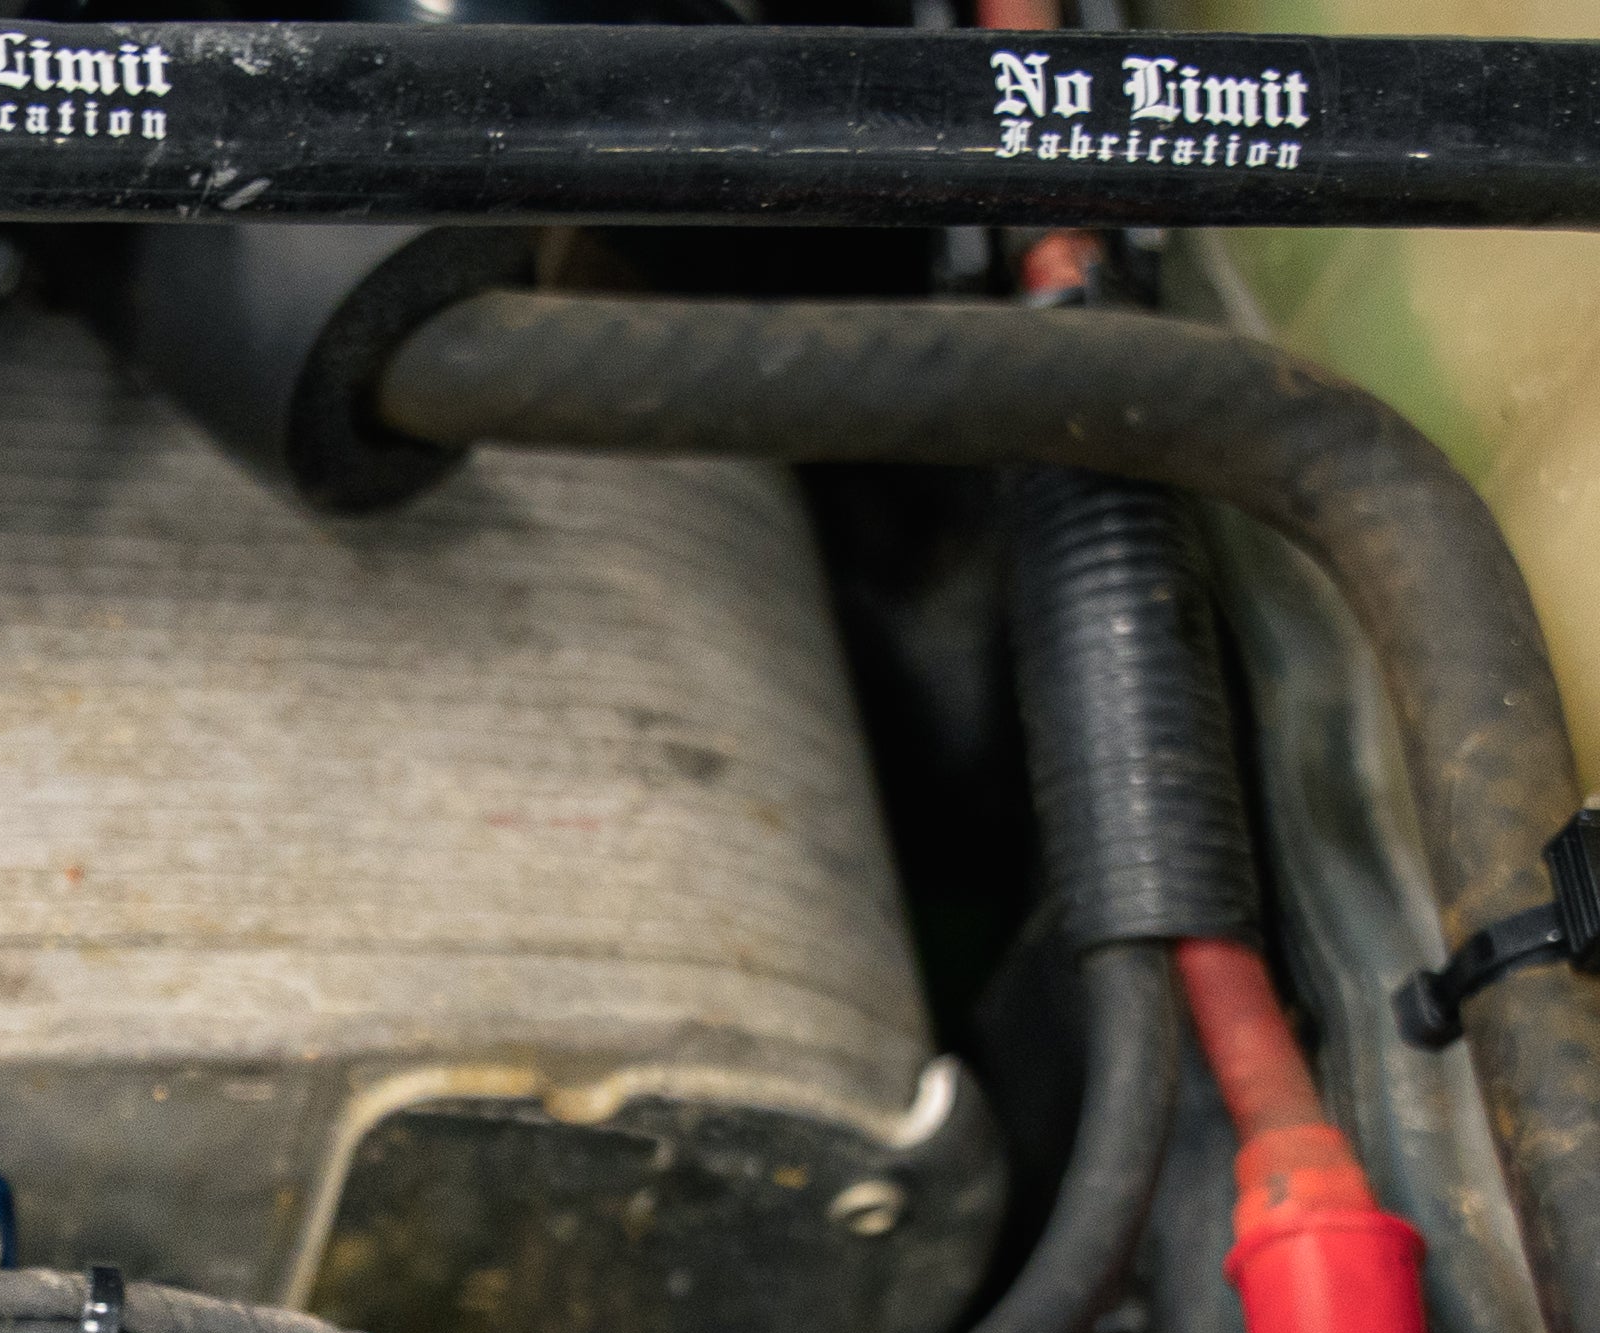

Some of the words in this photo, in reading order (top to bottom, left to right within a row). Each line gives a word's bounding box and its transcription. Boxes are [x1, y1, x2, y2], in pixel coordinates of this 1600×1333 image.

[991, 50, 1093, 118] No
[1123, 57, 1309, 128] Limit
[996, 119, 1301, 169] Fabrication
